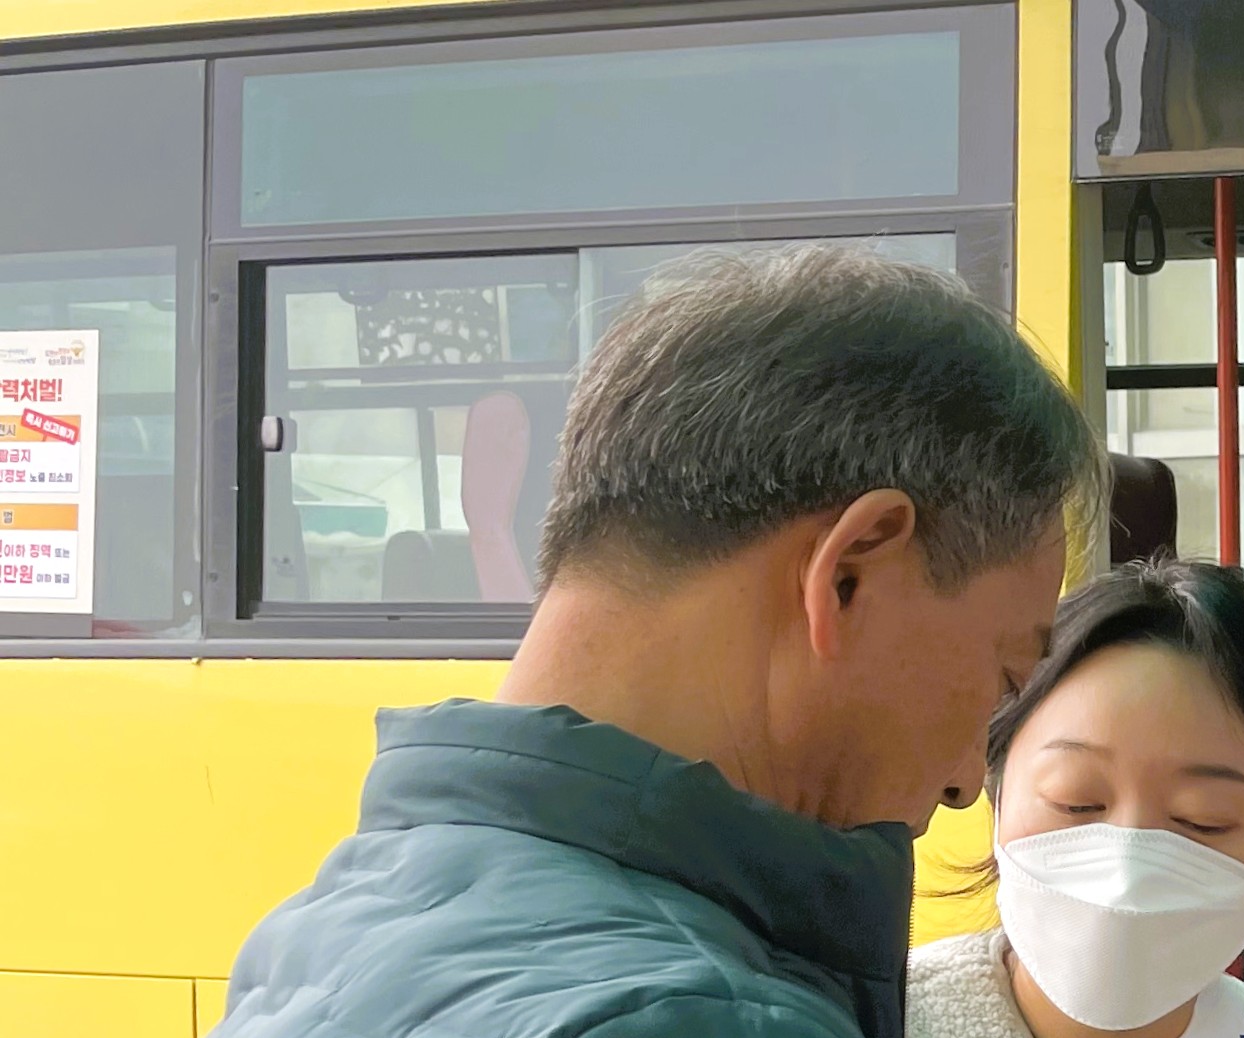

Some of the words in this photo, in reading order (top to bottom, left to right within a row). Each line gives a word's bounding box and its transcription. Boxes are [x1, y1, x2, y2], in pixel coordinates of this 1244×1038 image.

[0, 378, 63, 402] 력처벌!
[0, 540, 25, 558] 이하
[0, 565, 33, 584] 만원
